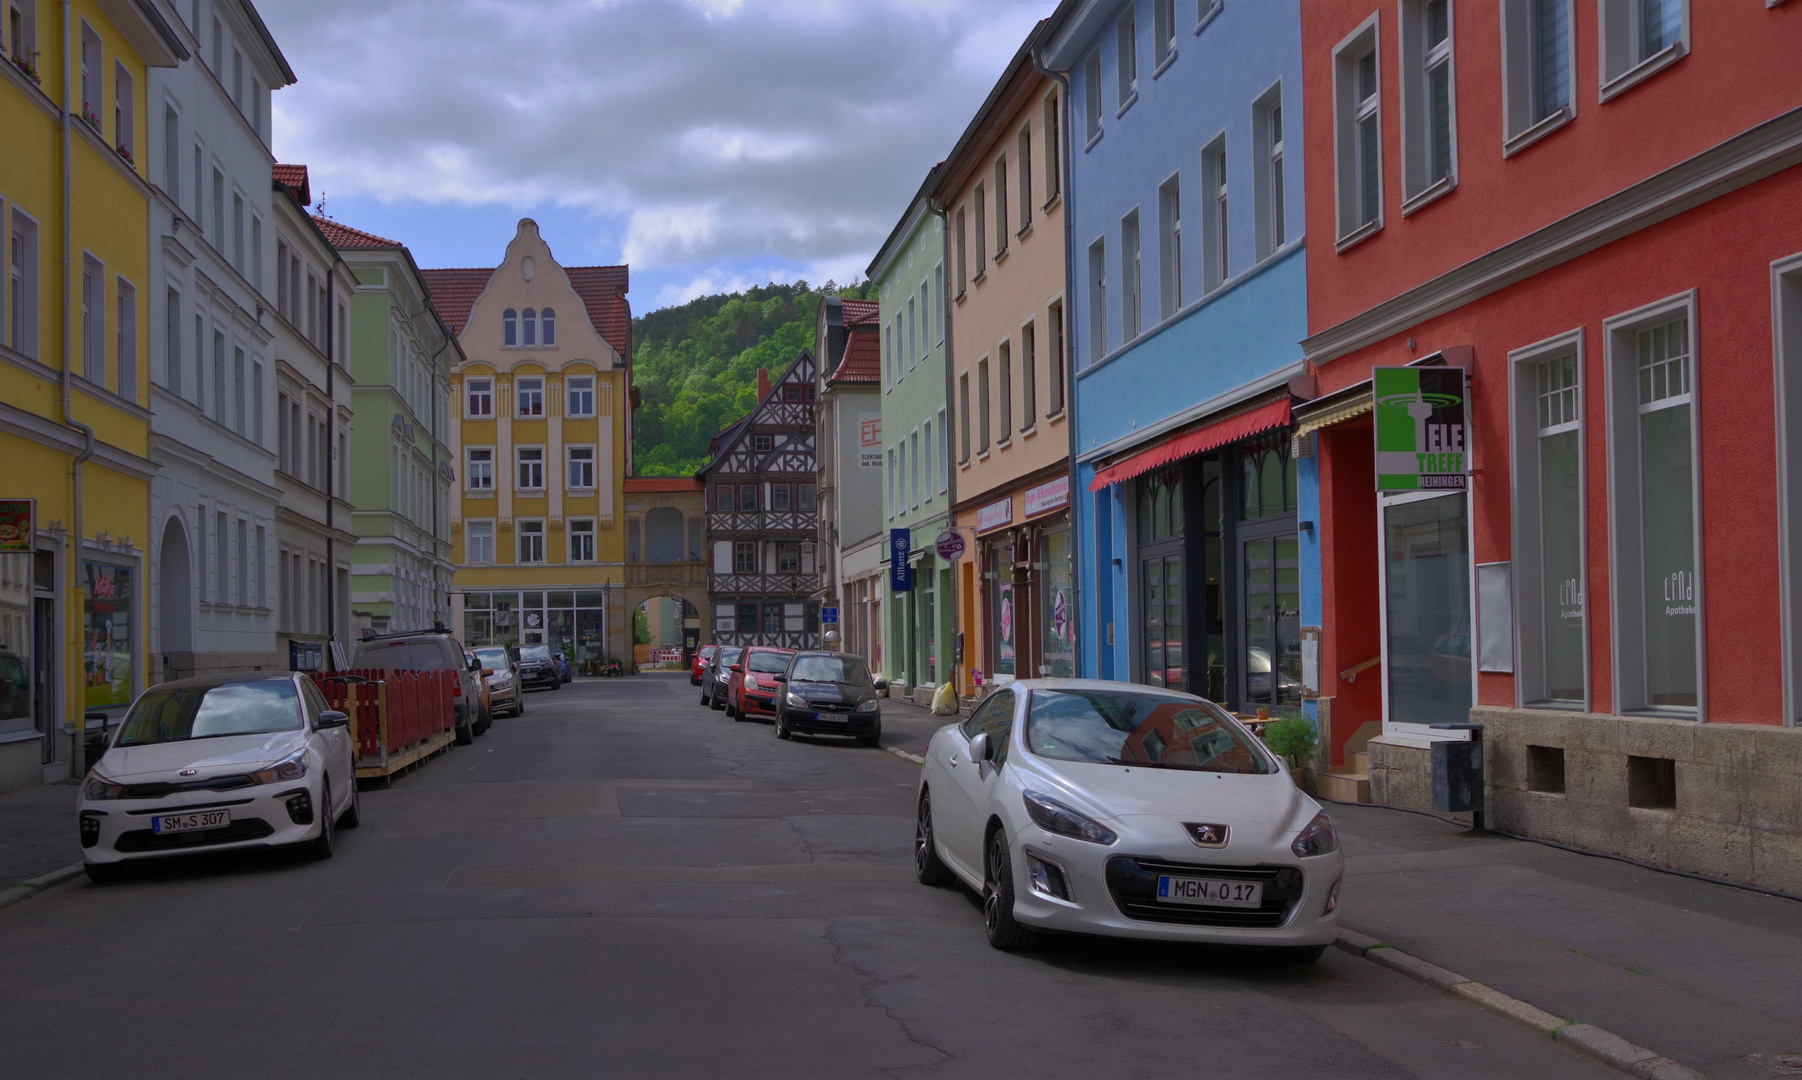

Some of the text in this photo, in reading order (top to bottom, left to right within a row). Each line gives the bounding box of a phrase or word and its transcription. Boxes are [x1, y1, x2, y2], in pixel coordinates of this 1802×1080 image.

[1416, 453, 1463, 473] TREFF
[1417, 476, 1464, 488] MEININGEN
[896, 551, 905, 582] Allianz
[165, 812, 224, 829] SM S 307
[1174, 880, 1208, 898] MGN
[1233, 884, 1255, 901] 17
